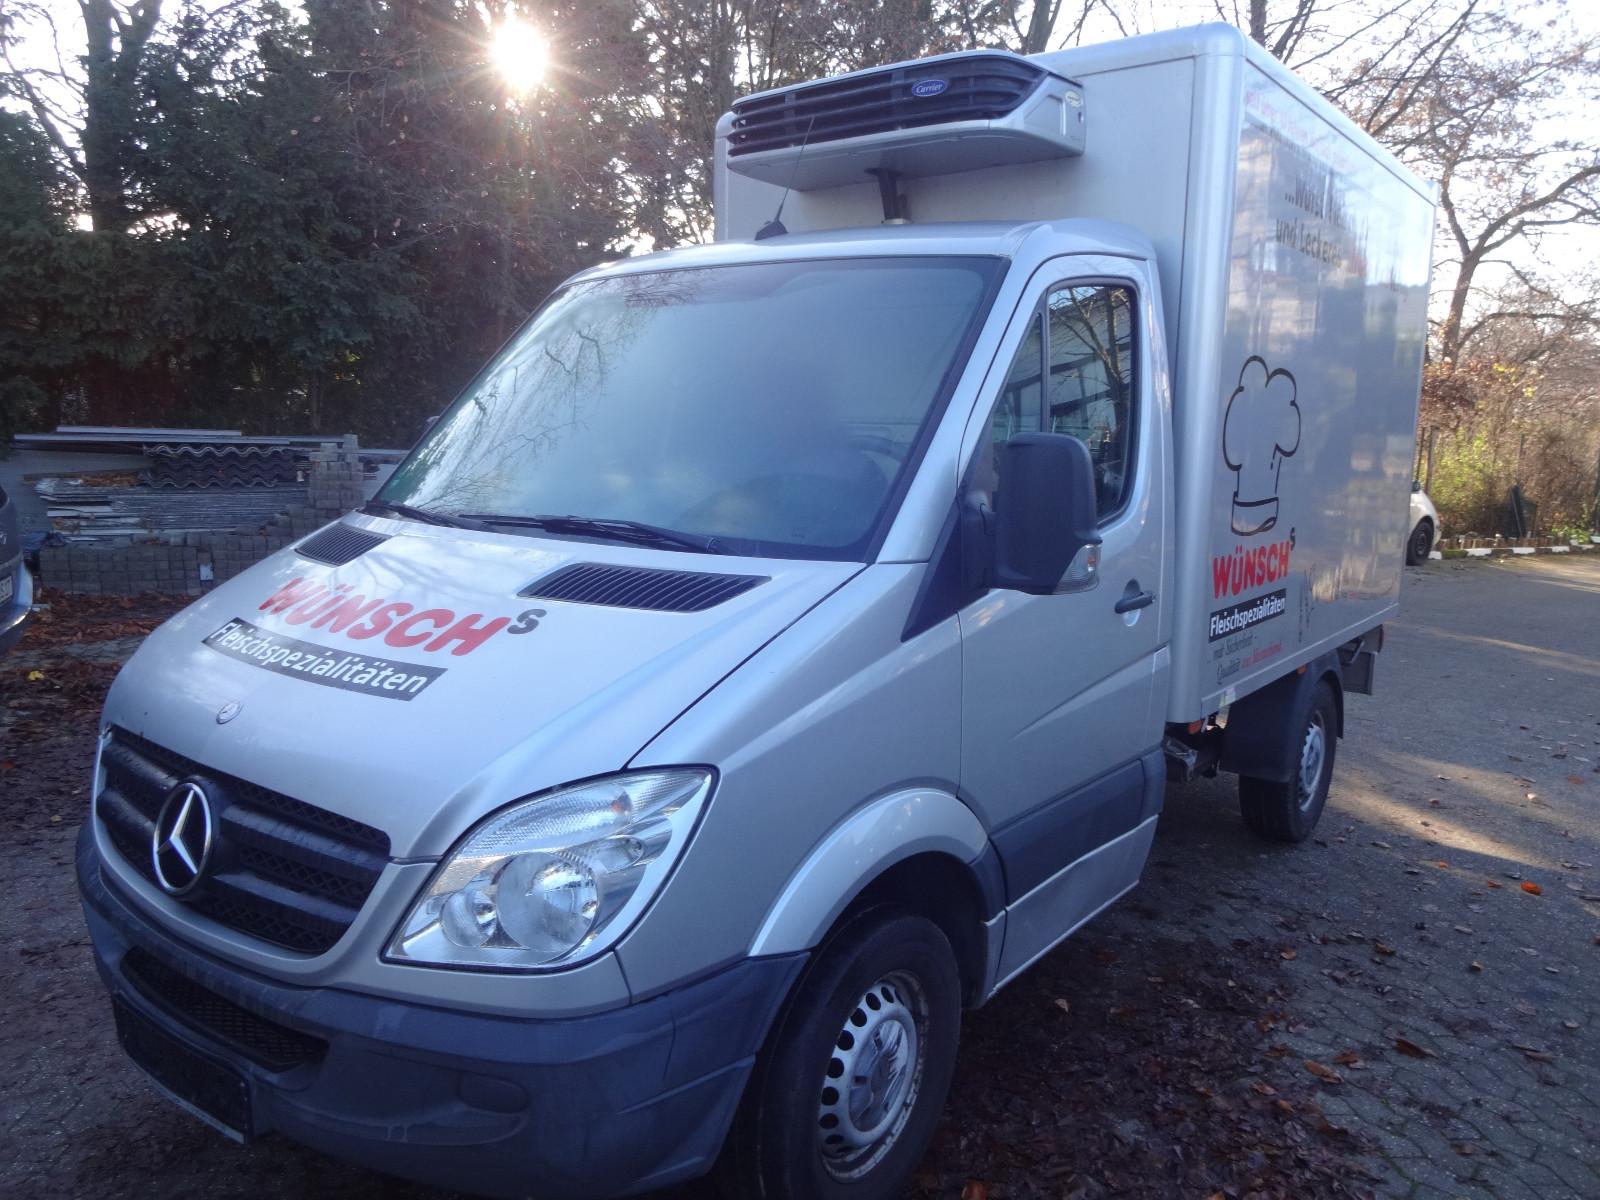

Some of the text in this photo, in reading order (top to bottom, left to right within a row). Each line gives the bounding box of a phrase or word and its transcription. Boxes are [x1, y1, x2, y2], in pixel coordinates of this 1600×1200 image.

[258, 577, 512, 656] WÜNSCH
[1210, 596, 1286, 637] Fleischspezialitäten
[209, 622, 428, 693] Fleischspezialitäten
